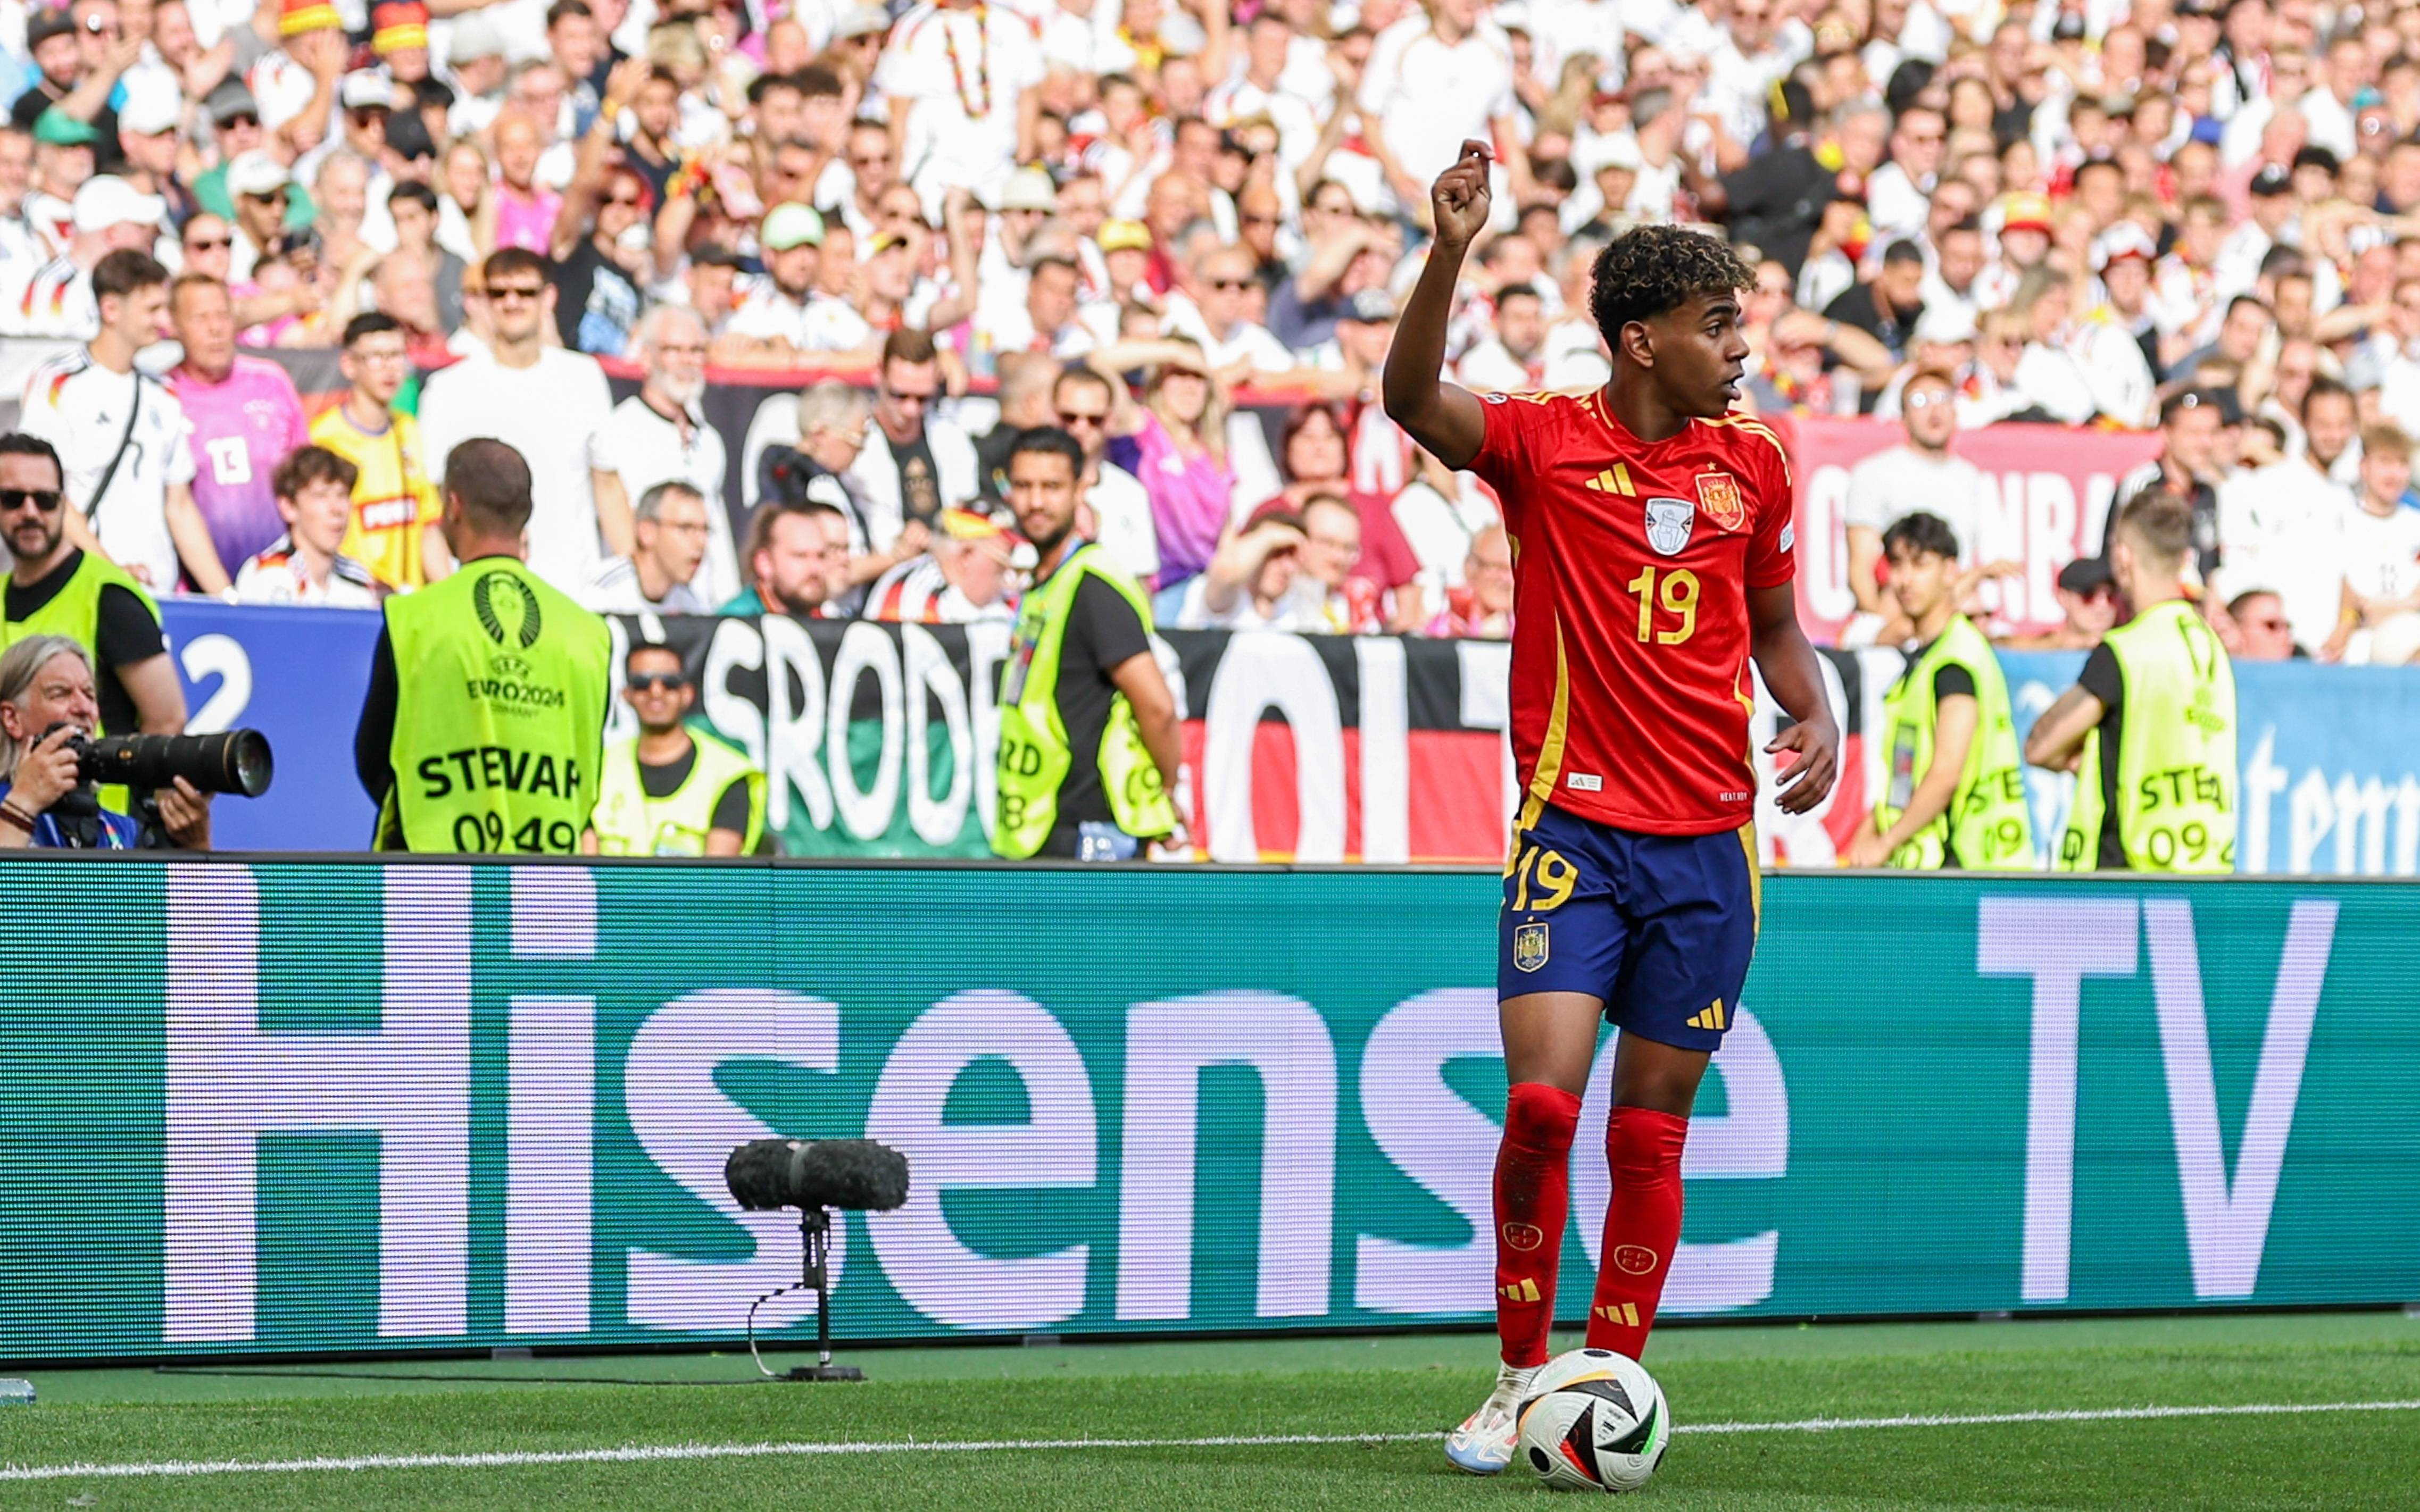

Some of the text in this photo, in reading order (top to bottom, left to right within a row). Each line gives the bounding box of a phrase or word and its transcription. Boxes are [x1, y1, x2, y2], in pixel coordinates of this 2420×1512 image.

[1628, 566, 1700, 645] 19
[1512, 846, 1579, 911] 19
[161, 863, 2339, 1342] Hisense TV
